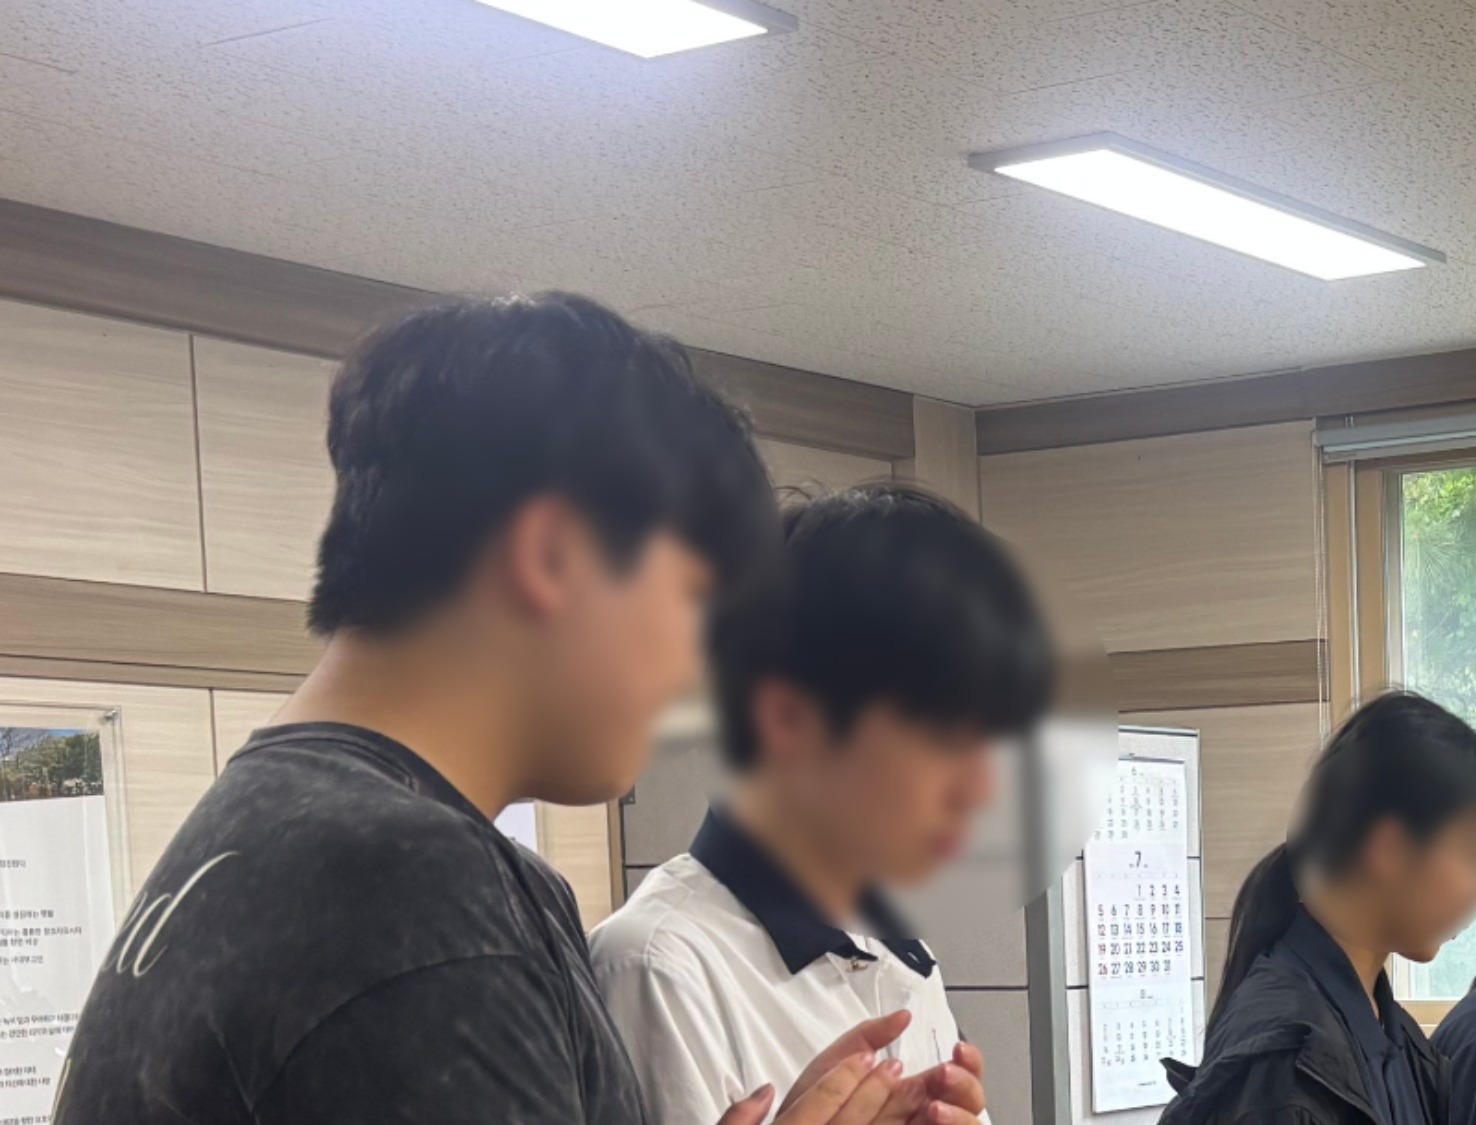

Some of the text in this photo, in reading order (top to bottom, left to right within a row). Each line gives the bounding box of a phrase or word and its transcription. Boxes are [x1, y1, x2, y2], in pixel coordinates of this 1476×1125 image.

[1134, 850, 1142, 868] 7
[1137, 884, 1180, 897] 1 2 3 4
[1098, 904, 1104, 916] 5
[1111, 904, 1117, 916] 6
[1124, 904, 1130, 916] 7
[1137, 904, 1143, 916] 8
[1150, 904, 1156, 916] 9
[1161, 904, 1170, 915] 10
[1097, 923, 1106, 936] 12
[1110, 923, 1119, 936] 13
[1123, 923, 1132, 935] 14
[1136, 922, 1145, 935] 15
[1149, 922, 1158, 935] 16
[1098, 940, 1183, 955] 19 20 21 22 23 24 25
[1098, 960, 1171, 975] 26 27 28 29 30 31
